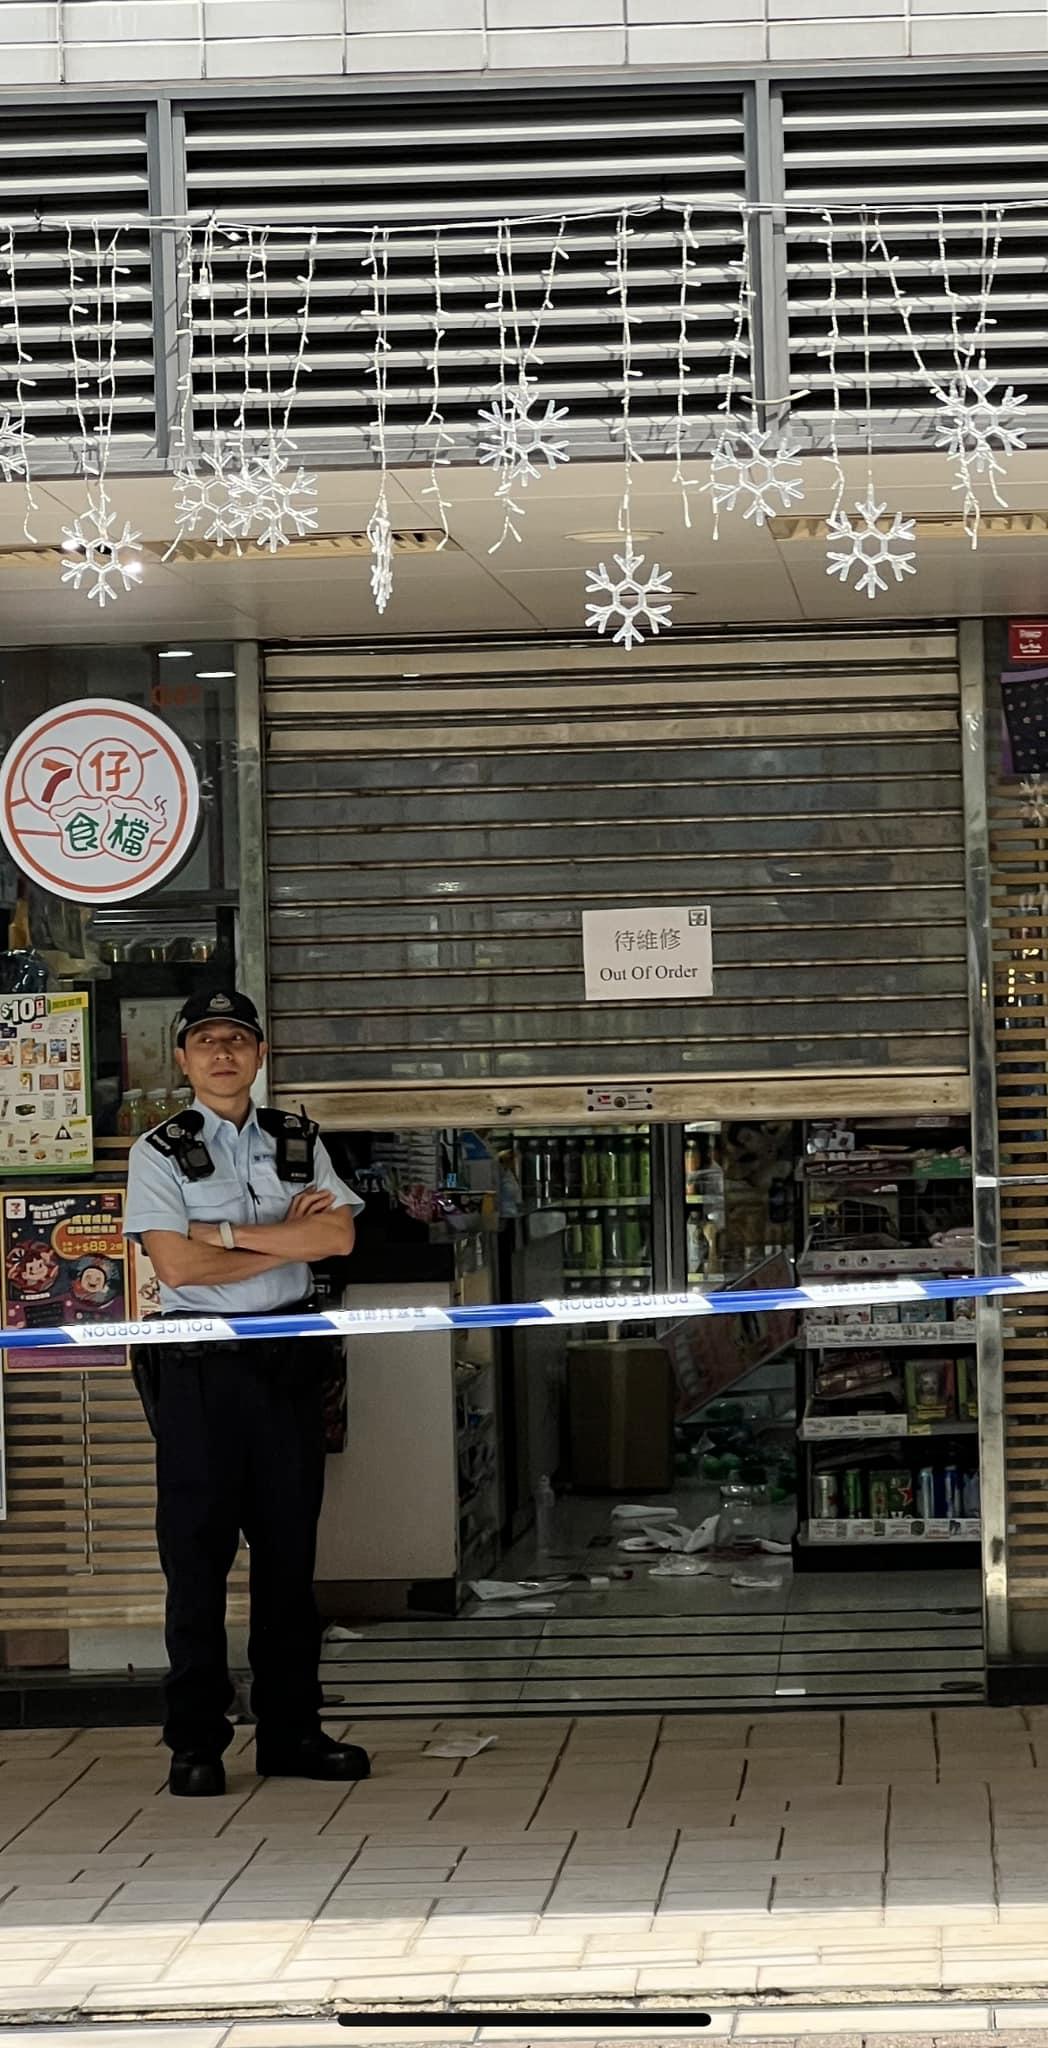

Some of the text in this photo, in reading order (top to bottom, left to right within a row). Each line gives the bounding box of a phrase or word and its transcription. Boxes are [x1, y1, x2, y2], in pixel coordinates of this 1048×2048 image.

[64, 811, 150, 856] 食檔
[614, 928, 682, 953] 待維修
[600, 964, 698, 982] Out Of Order
[1, 998, 36, 1023] $10
[559, 1295, 689, 1312] POLICE CORDON
[82, 1319, 214, 1338] POLICE CORDON
